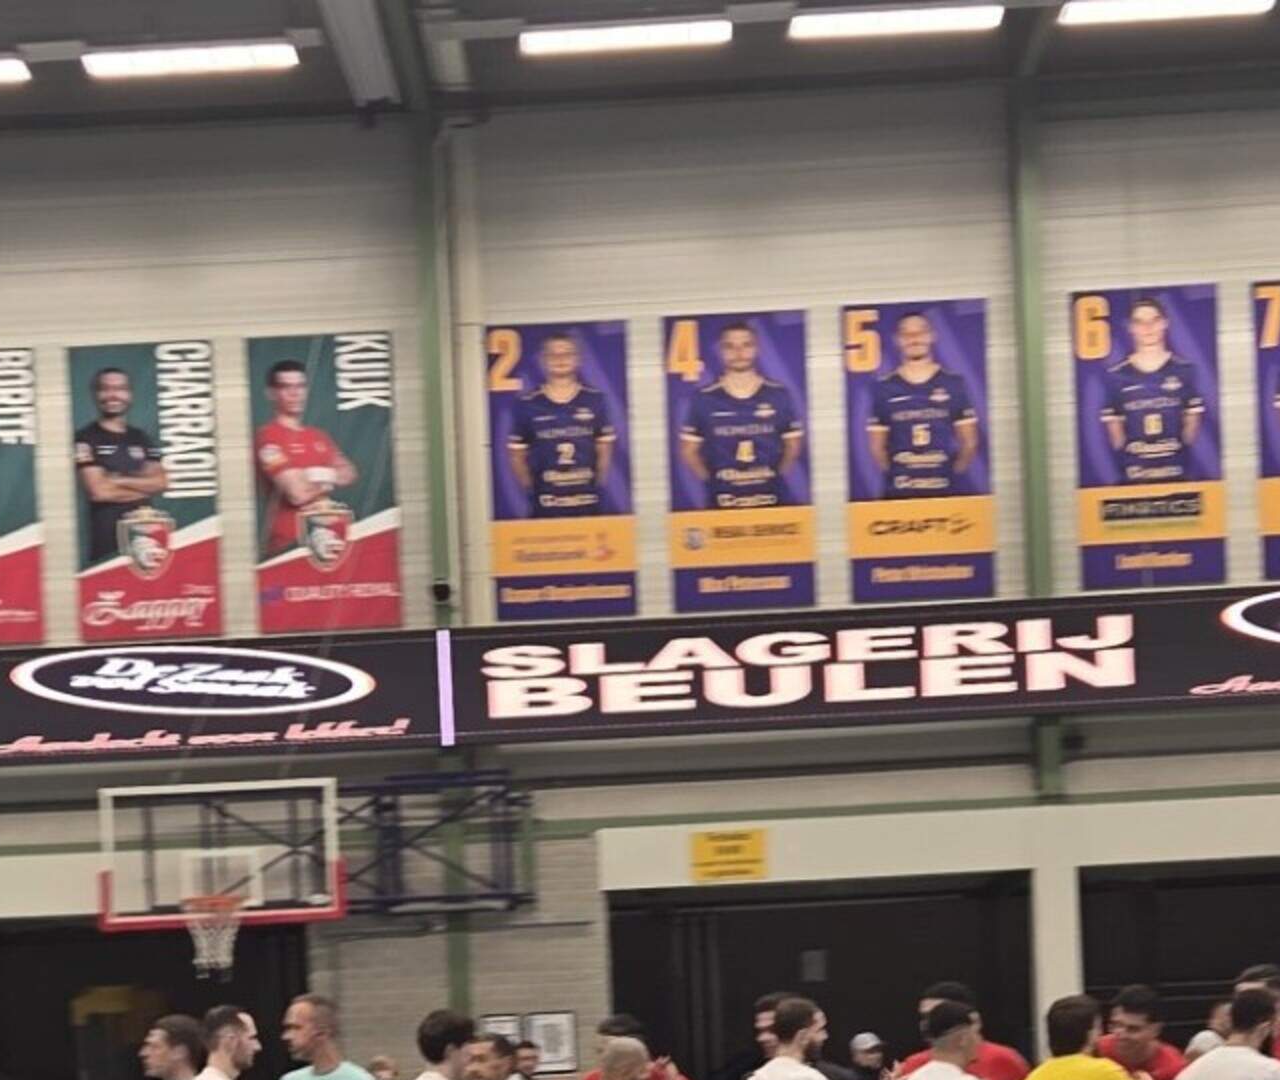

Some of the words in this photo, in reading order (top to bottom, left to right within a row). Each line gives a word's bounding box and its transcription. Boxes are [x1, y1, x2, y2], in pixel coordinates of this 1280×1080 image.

[667, 320, 704, 381] 4
[844, 310, 880, 372] 5
[1074, 296, 1110, 359] 6
[487, 329, 524, 391] 2
[155, 341, 218, 499] CHARRAOUI
[869, 517, 950, 536] CRAFT
[481, 615, 1133, 679] SLAGERIJ
[486, 648, 1136, 719] BEULEN
